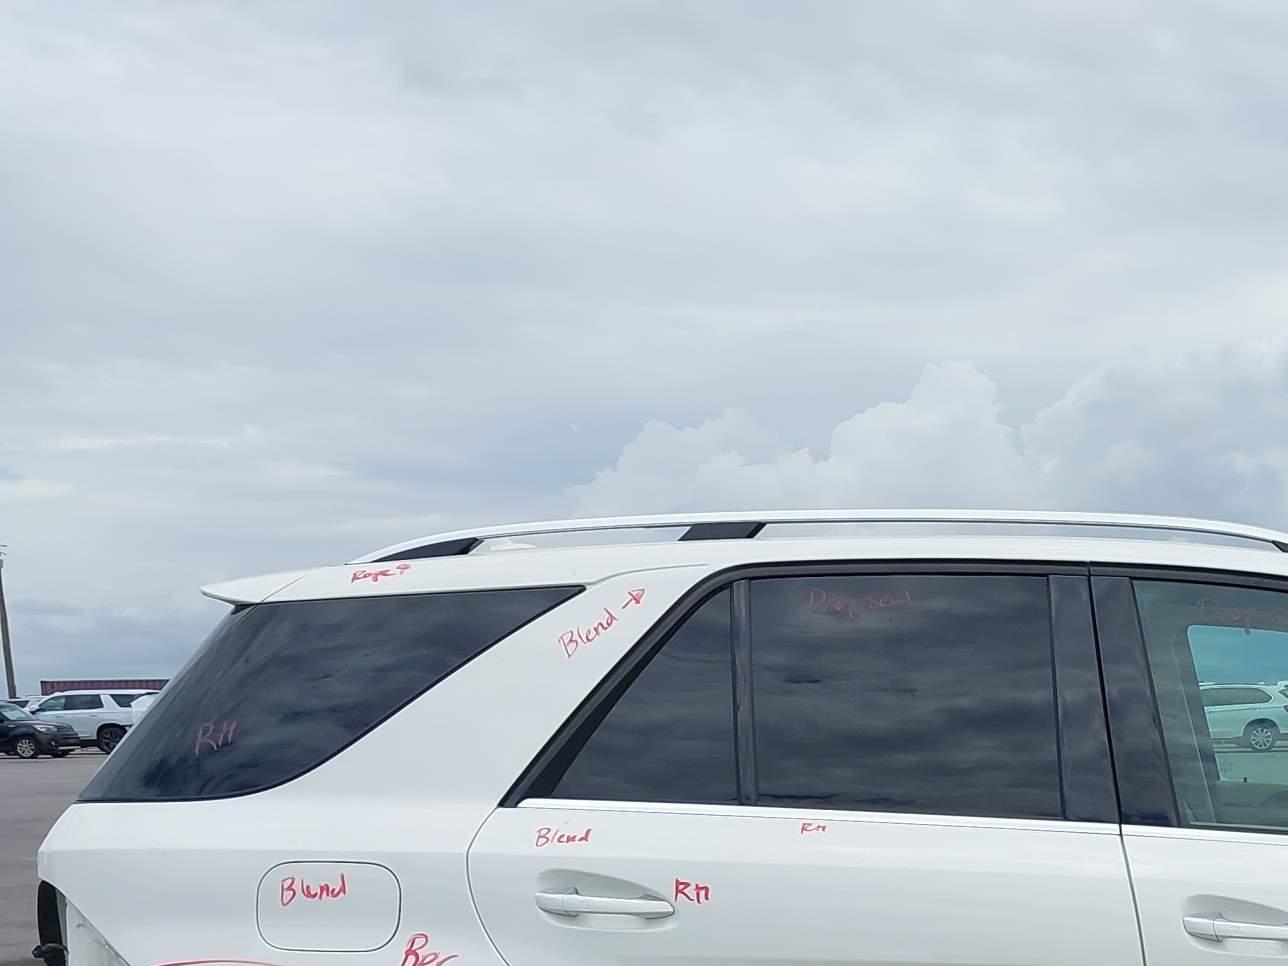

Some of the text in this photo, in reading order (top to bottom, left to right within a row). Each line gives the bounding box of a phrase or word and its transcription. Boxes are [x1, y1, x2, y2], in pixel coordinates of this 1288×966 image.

[559, 608, 618, 658] Blend
[535, 827, 592, 847] Blend
[280, 873, 346, 906] Blend
